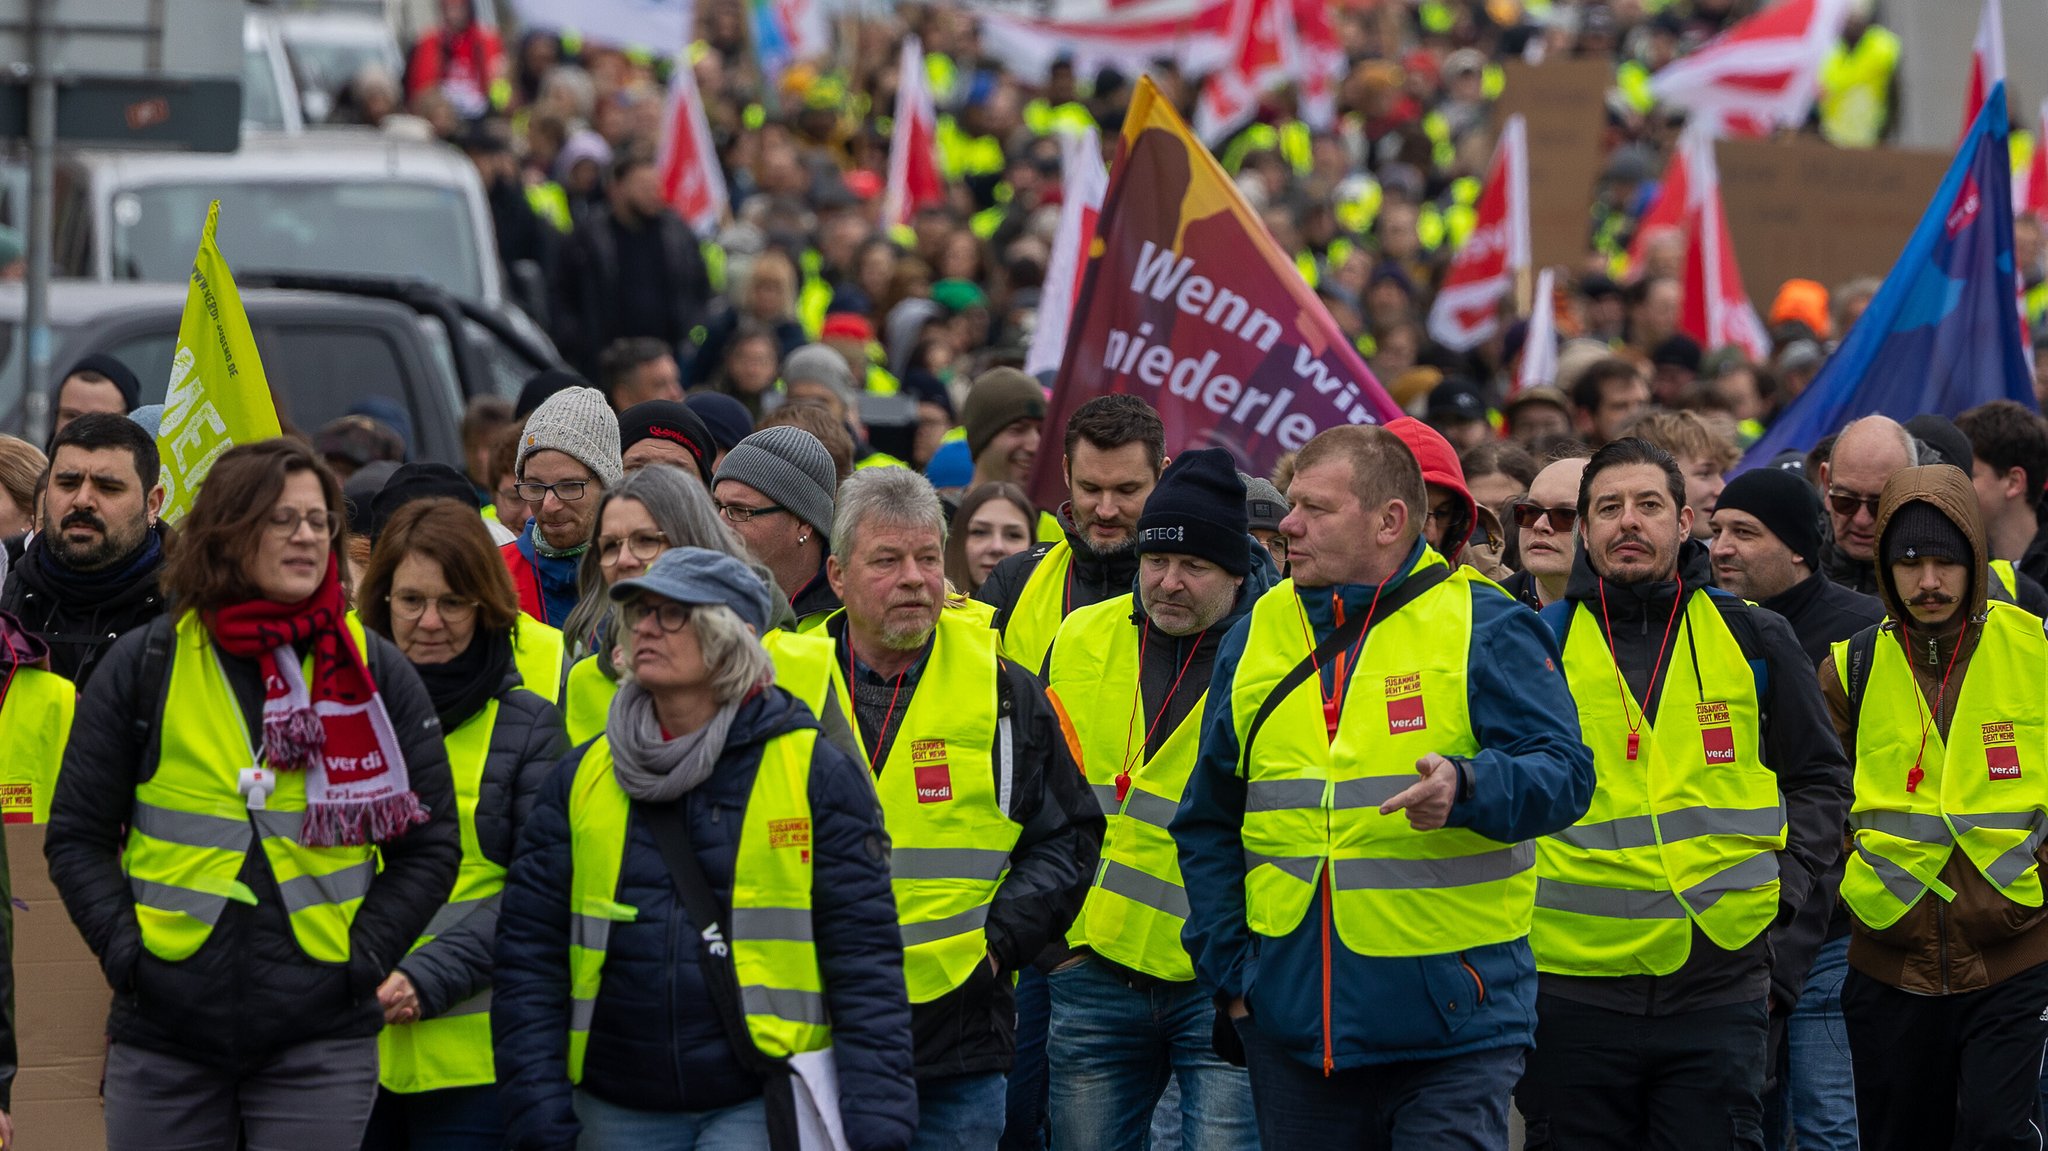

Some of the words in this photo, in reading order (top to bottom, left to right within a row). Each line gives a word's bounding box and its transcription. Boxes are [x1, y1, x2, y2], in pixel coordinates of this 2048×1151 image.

[1130, 240, 1284, 352] Wenn
[1292, 344, 1377, 426] wir
[1696, 703, 1729, 714] ZUSAMMEN
[1391, 716, 1424, 728] ver.di
[1697, 713, 1713, 722] GEHT
[1713, 711, 1730, 721] MEHR
[1982, 724, 2014, 734] ZUSAMMEN
[1983, 733, 1998, 742] GEHT
[1999, 732, 2015, 740] MEHR
[1706, 748, 1734, 758] ver.di
[326, 756, 358, 771] ver
[361, 750, 382, 770] di
[1990, 766, 2019, 775] ver.di
[918, 786, 950, 798] ver.di
[701, 921, 729, 958] ve
